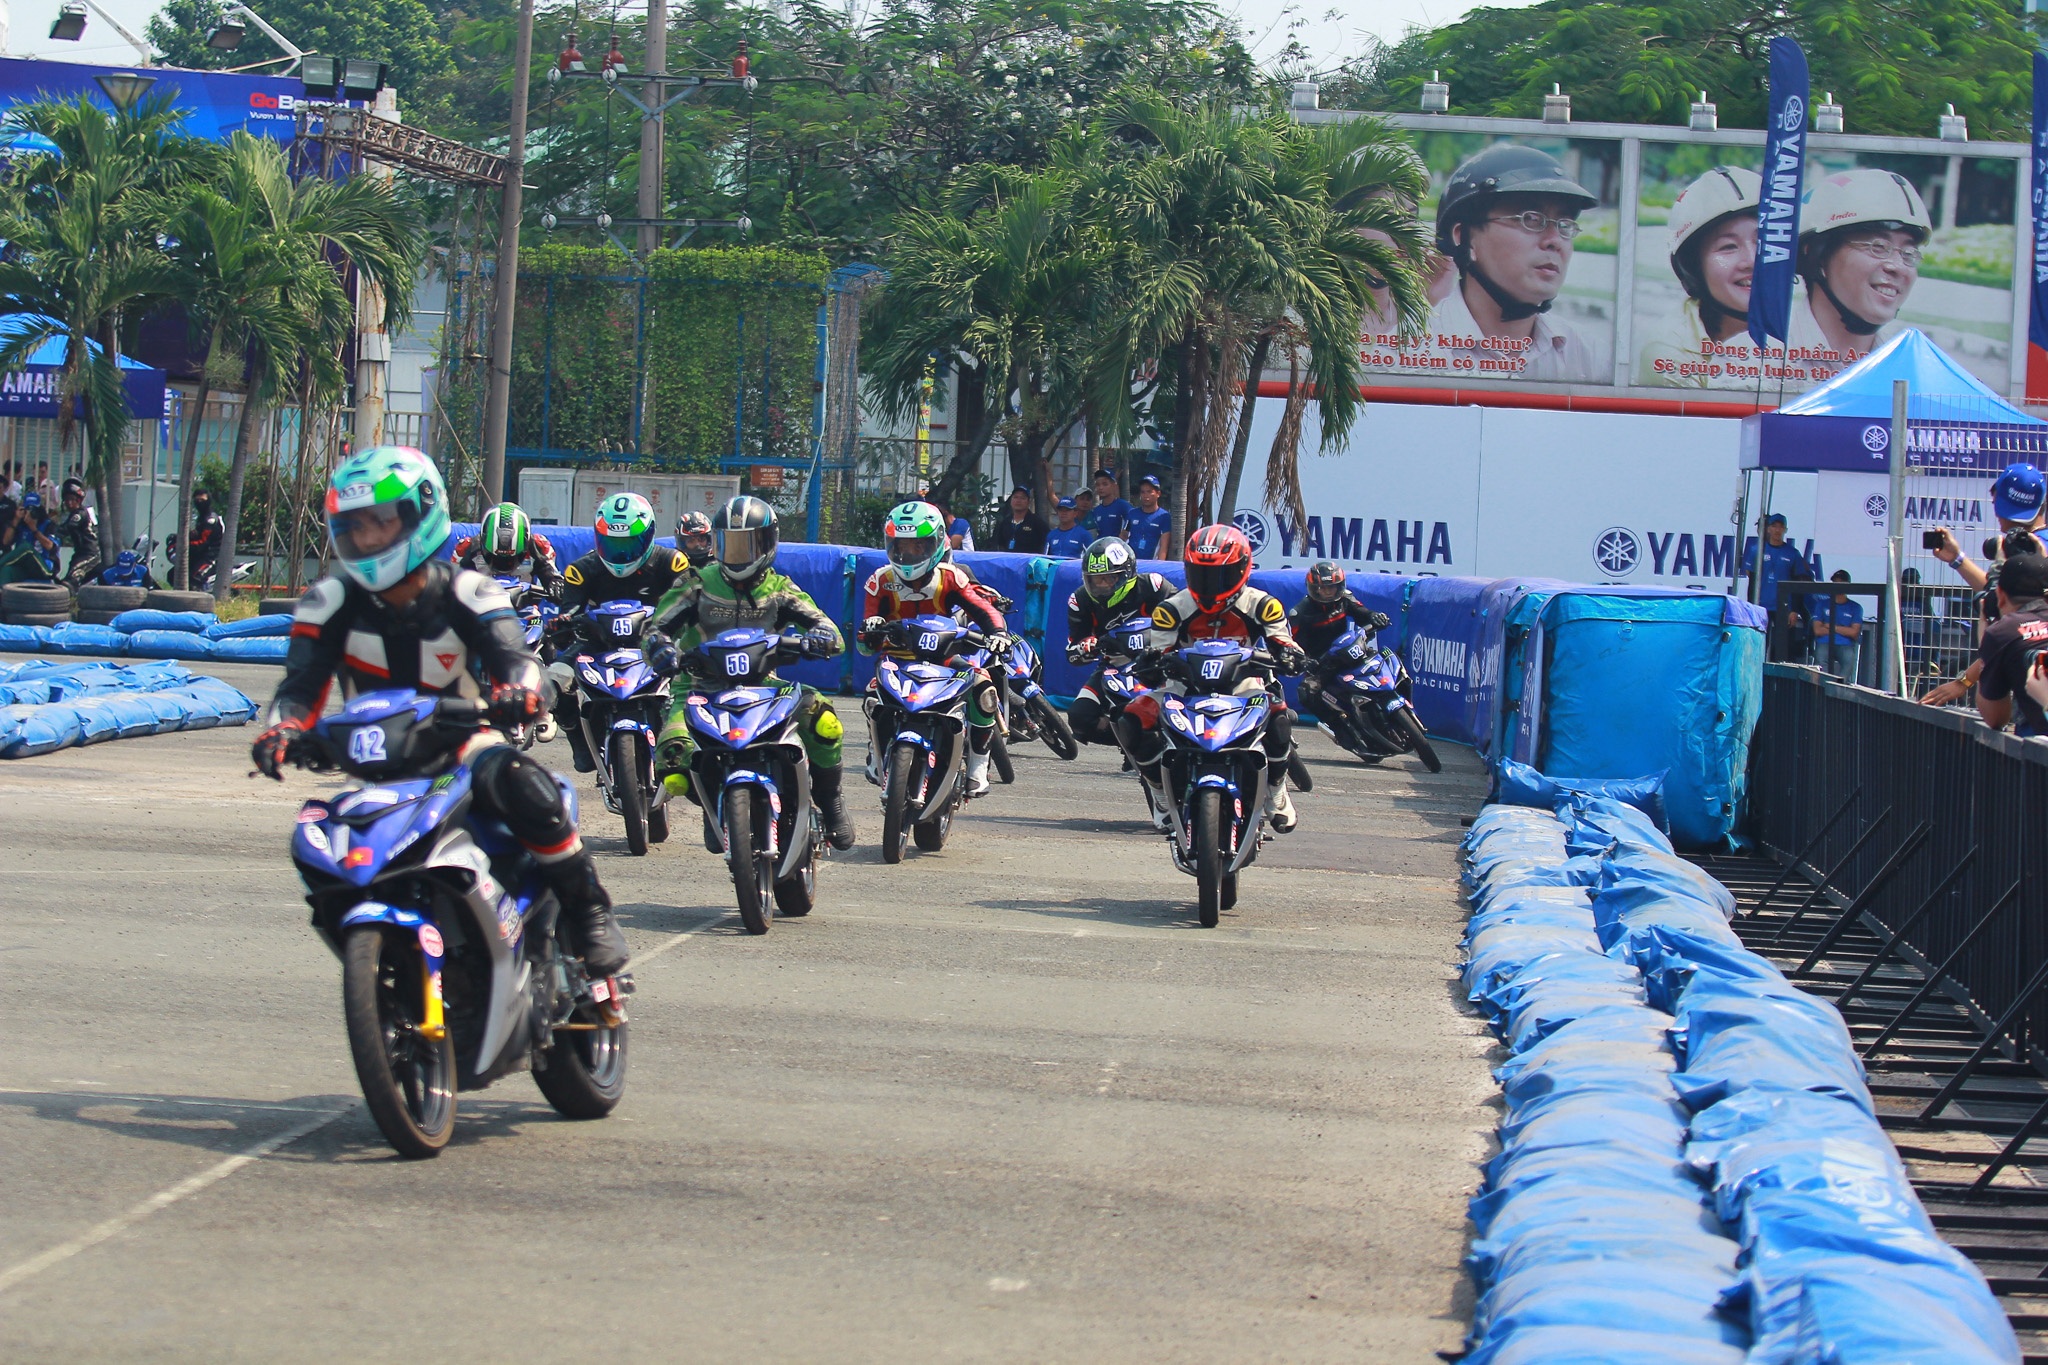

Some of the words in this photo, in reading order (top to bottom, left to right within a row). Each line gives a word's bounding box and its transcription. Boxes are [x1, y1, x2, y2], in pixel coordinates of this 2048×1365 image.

[1763, 134, 1801, 265] YAMAHA
[1437, 333, 1476, 348] khó
[1480, 336, 1533, 354] chịu?
[1700, 340, 1748, 360] Dòng
[1788, 342, 1839, 362] phẩm
[1360, 349, 1394, 366] bảo
[1399, 349, 1448, 369] hiểm
[1452, 355, 1475, 369] có
[1479, 357, 1528, 372] mùi?
[1653, 358, 1676, 373] Sẽ
[1679, 359, 1722, 378] giúp
[1726, 362, 1760, 379] bạn
[1764, 363, 1806, 379] luôn
[2, 371, 64, 394] AMAH
[1902, 428, 1981, 454] AMAHA
[1872, 452, 1974, 463] RCING
[1904, 496, 1983, 523] AMAHA
[1275, 513, 1453, 565] YAMAHA
[1647, 531, 1825, 583] YAMA
[613, 618, 632, 636] 45
[919, 633, 939, 651] 48
[1128, 634, 1144, 650] 41
[1348, 644, 1365, 660] 52
[726, 652, 750, 676] 56
[1423, 637, 1467, 679] YAMAHA
[1201, 660, 1223, 680] 47
[1415, 676, 1460, 692] RACING
[348, 725, 387, 764] 42
